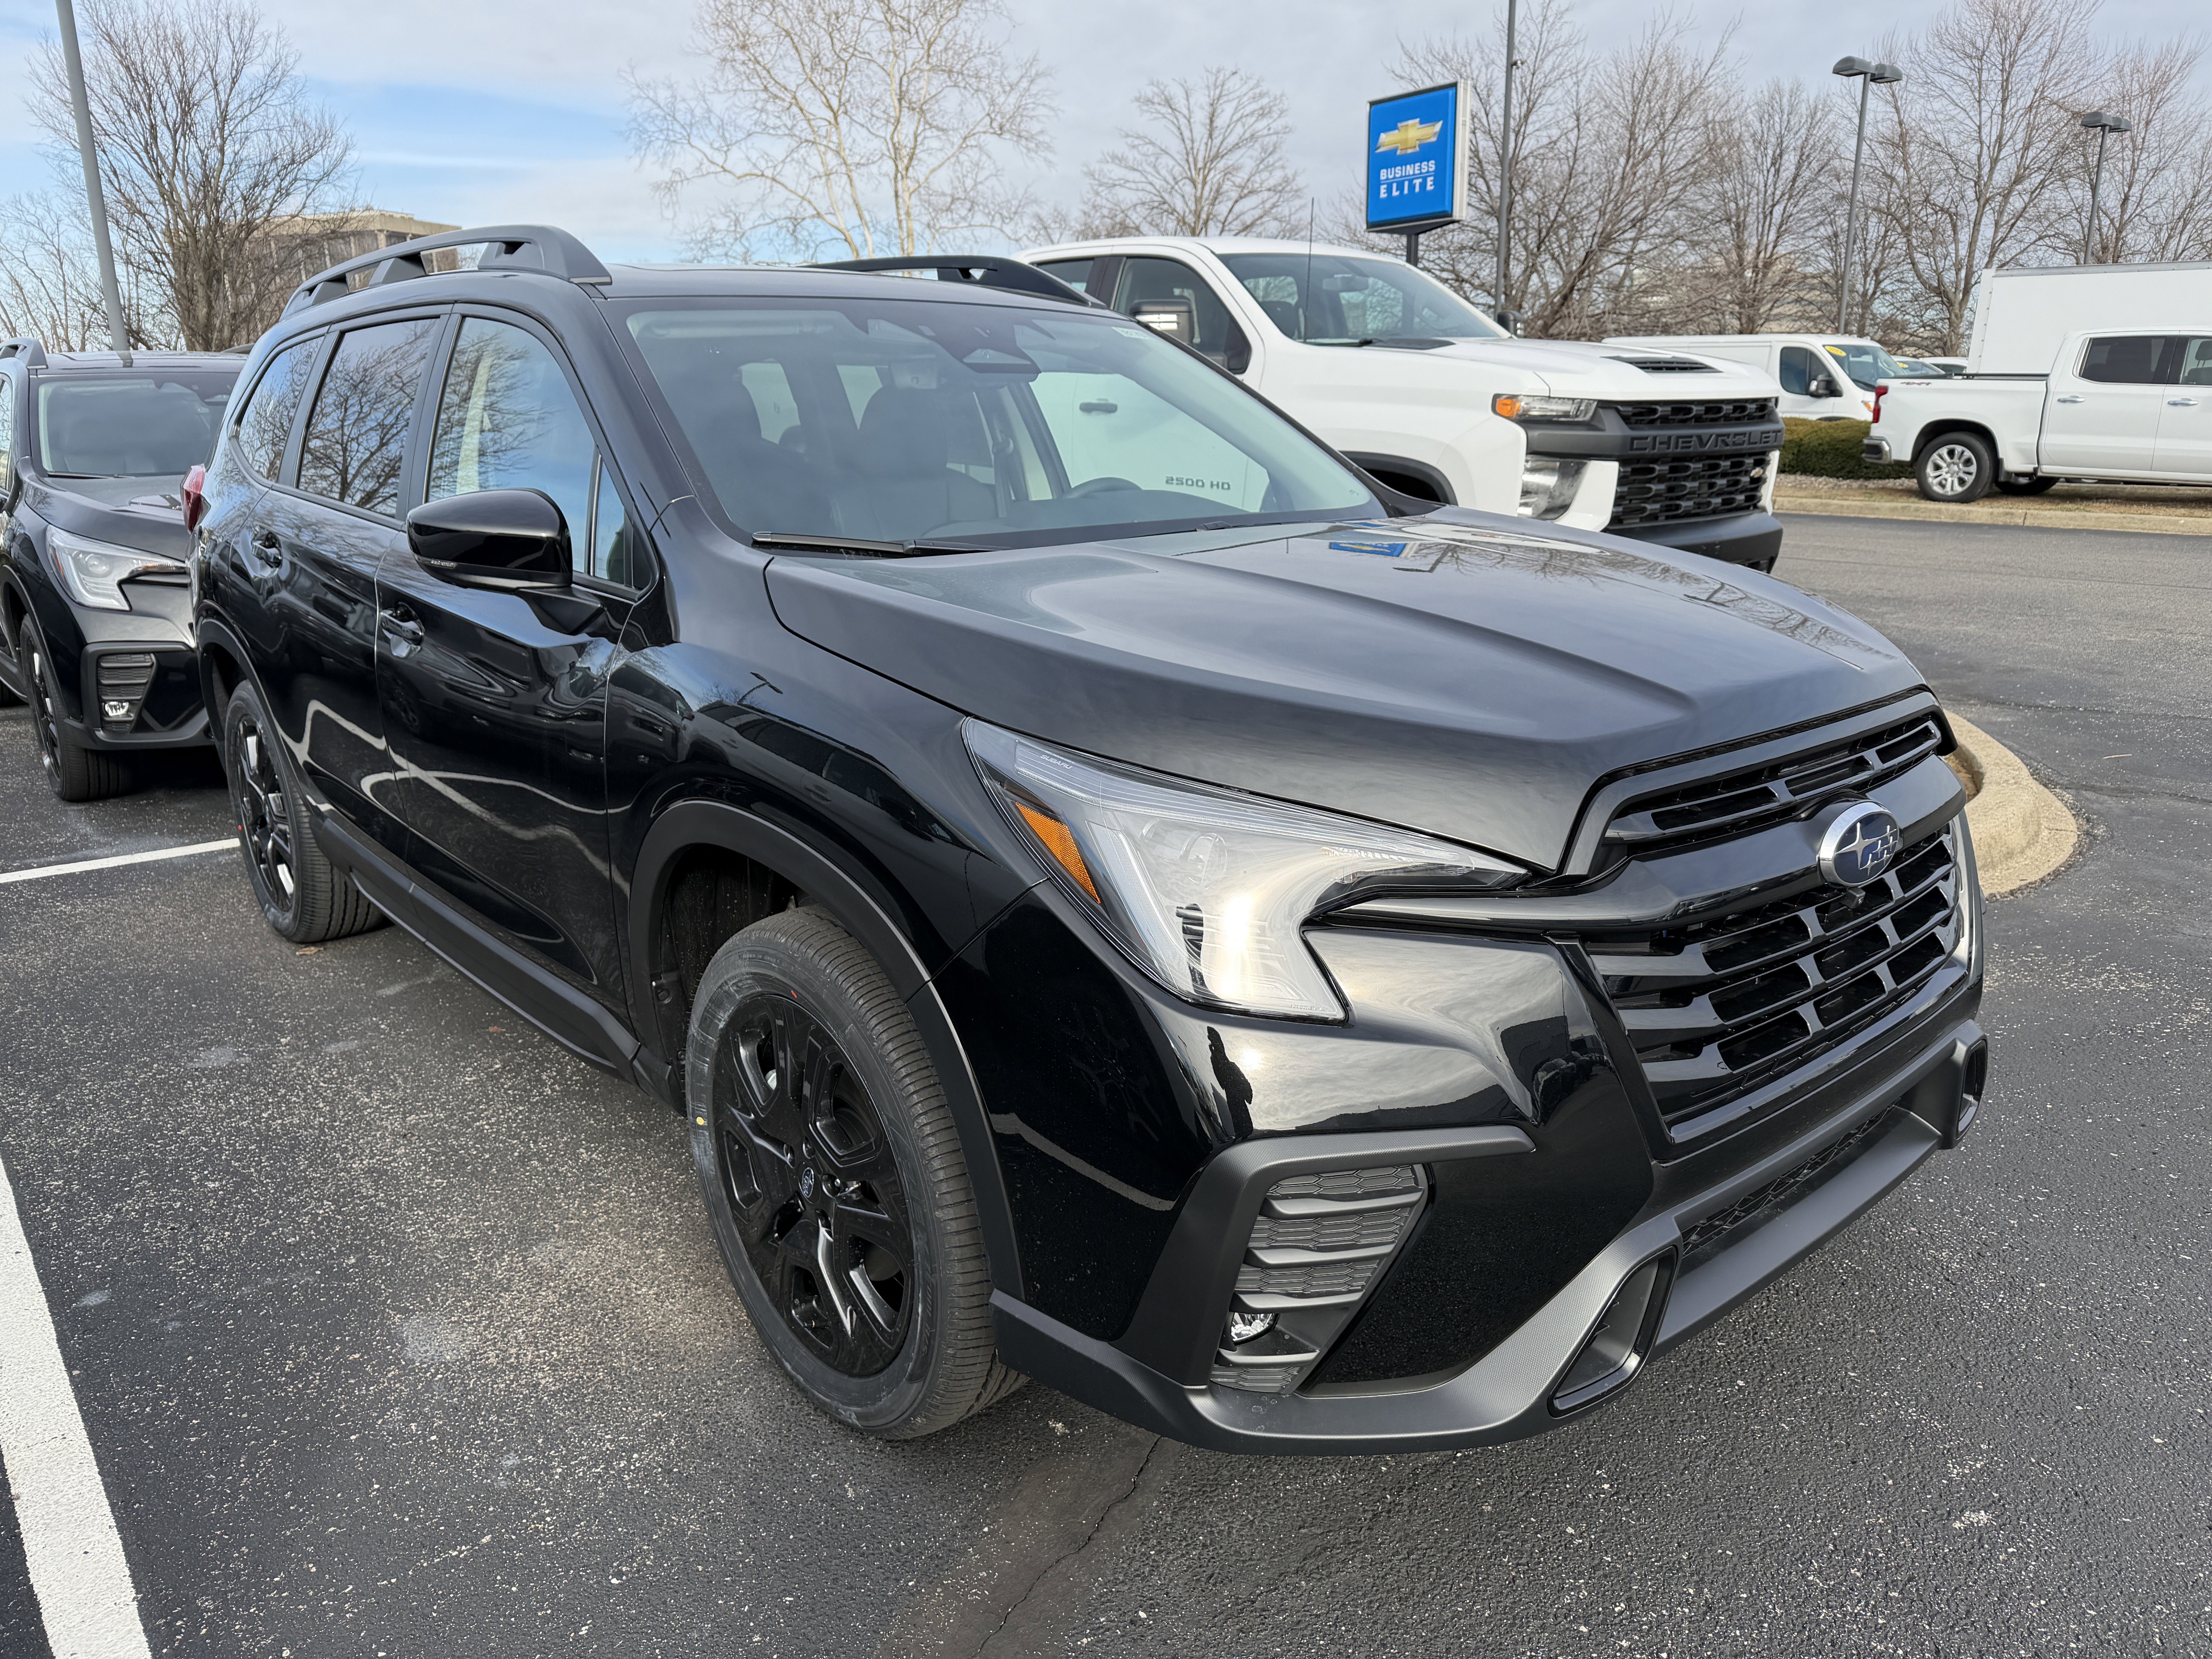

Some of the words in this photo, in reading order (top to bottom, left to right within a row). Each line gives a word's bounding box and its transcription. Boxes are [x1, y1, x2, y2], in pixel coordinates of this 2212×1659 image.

[1380, 160, 1436, 180] BUSINESS
[1379, 176, 1435, 198] ELITE
[1629, 430, 1781, 452] CHEVROLET
[1165, 476, 1205, 488] 2500
[1210, 480, 1231, 490] HD
[1040, 754, 1073, 769] SUBARU
